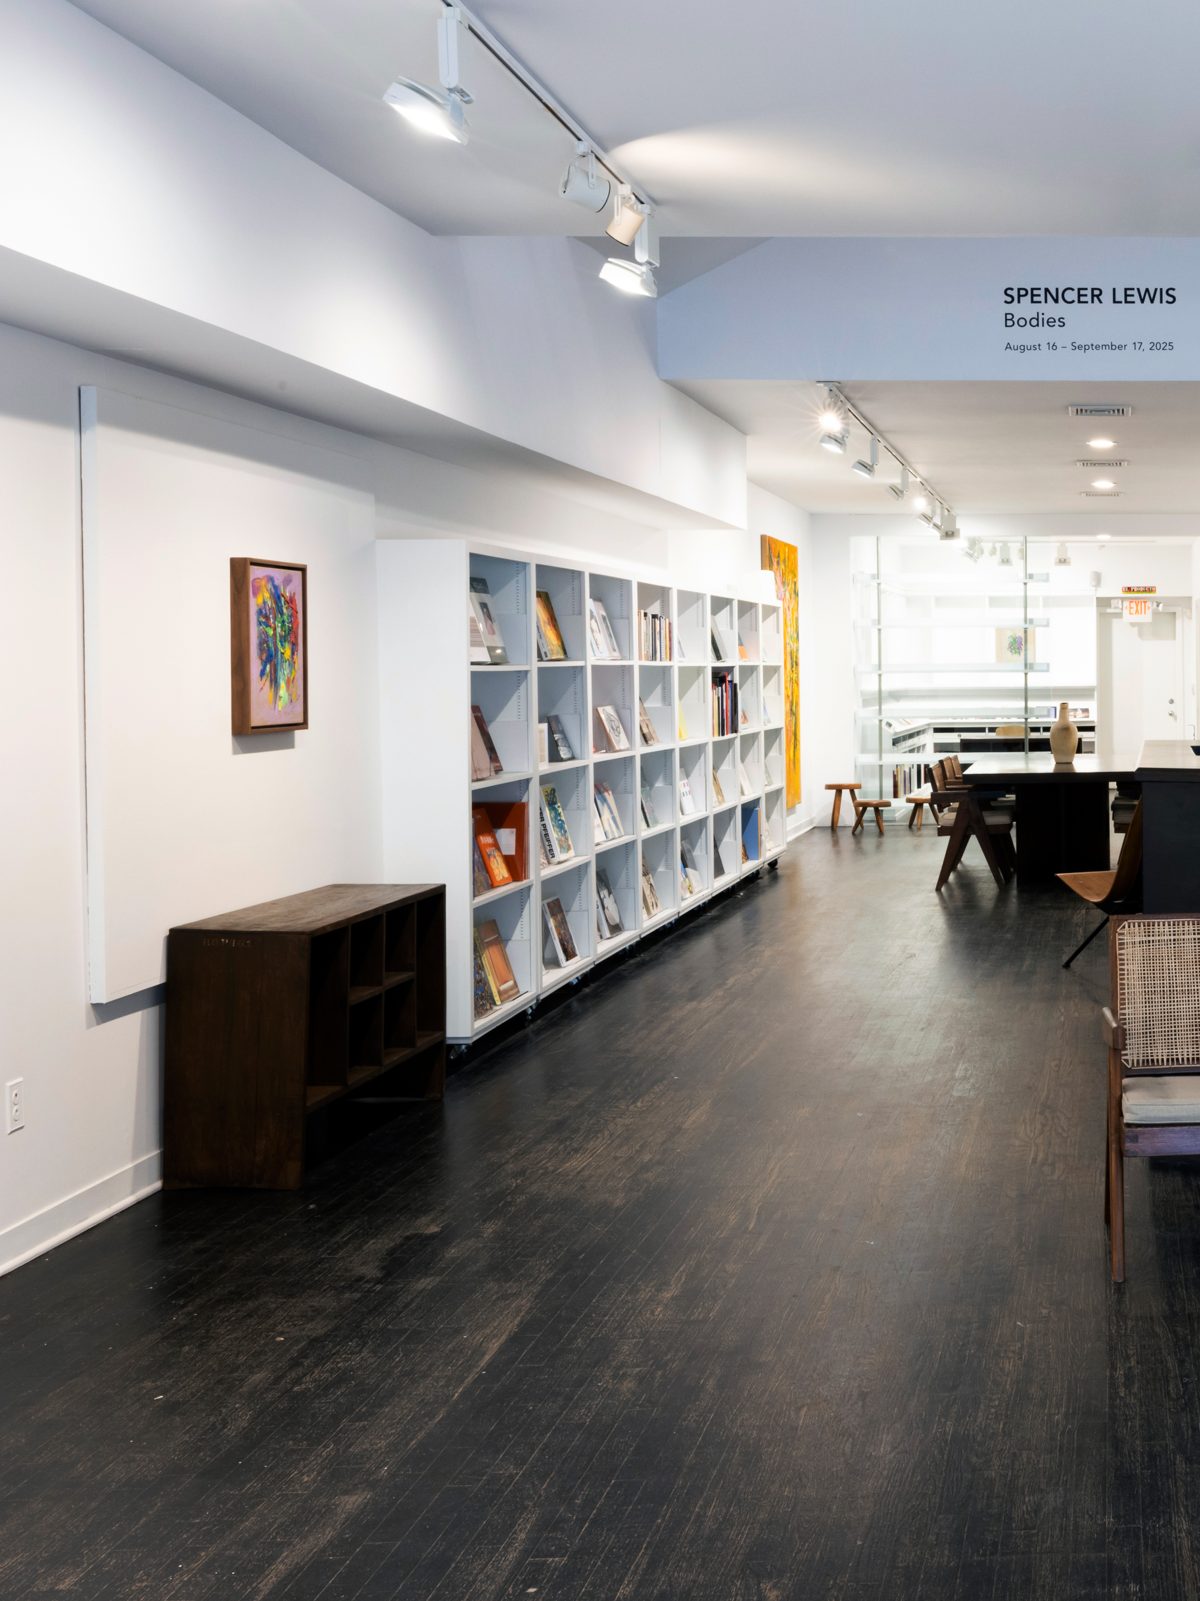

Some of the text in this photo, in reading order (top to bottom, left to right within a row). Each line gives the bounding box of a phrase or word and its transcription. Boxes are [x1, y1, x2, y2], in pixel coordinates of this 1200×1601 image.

[1003, 287, 1177, 304] SPENCER LEWIS
[1004, 312, 1066, 328] Bodies
[1005, 342, 1042, 354] August
[1047, 342, 1058, 351] 16
[1071, 341, 1128, 353] September
[1133, 342, 1145, 352] 17,
[1149, 342, 1174, 351] 2025
[1128, 600, 1147, 615] EXIT
[541, 823, 556, 859] PFEIFFER
